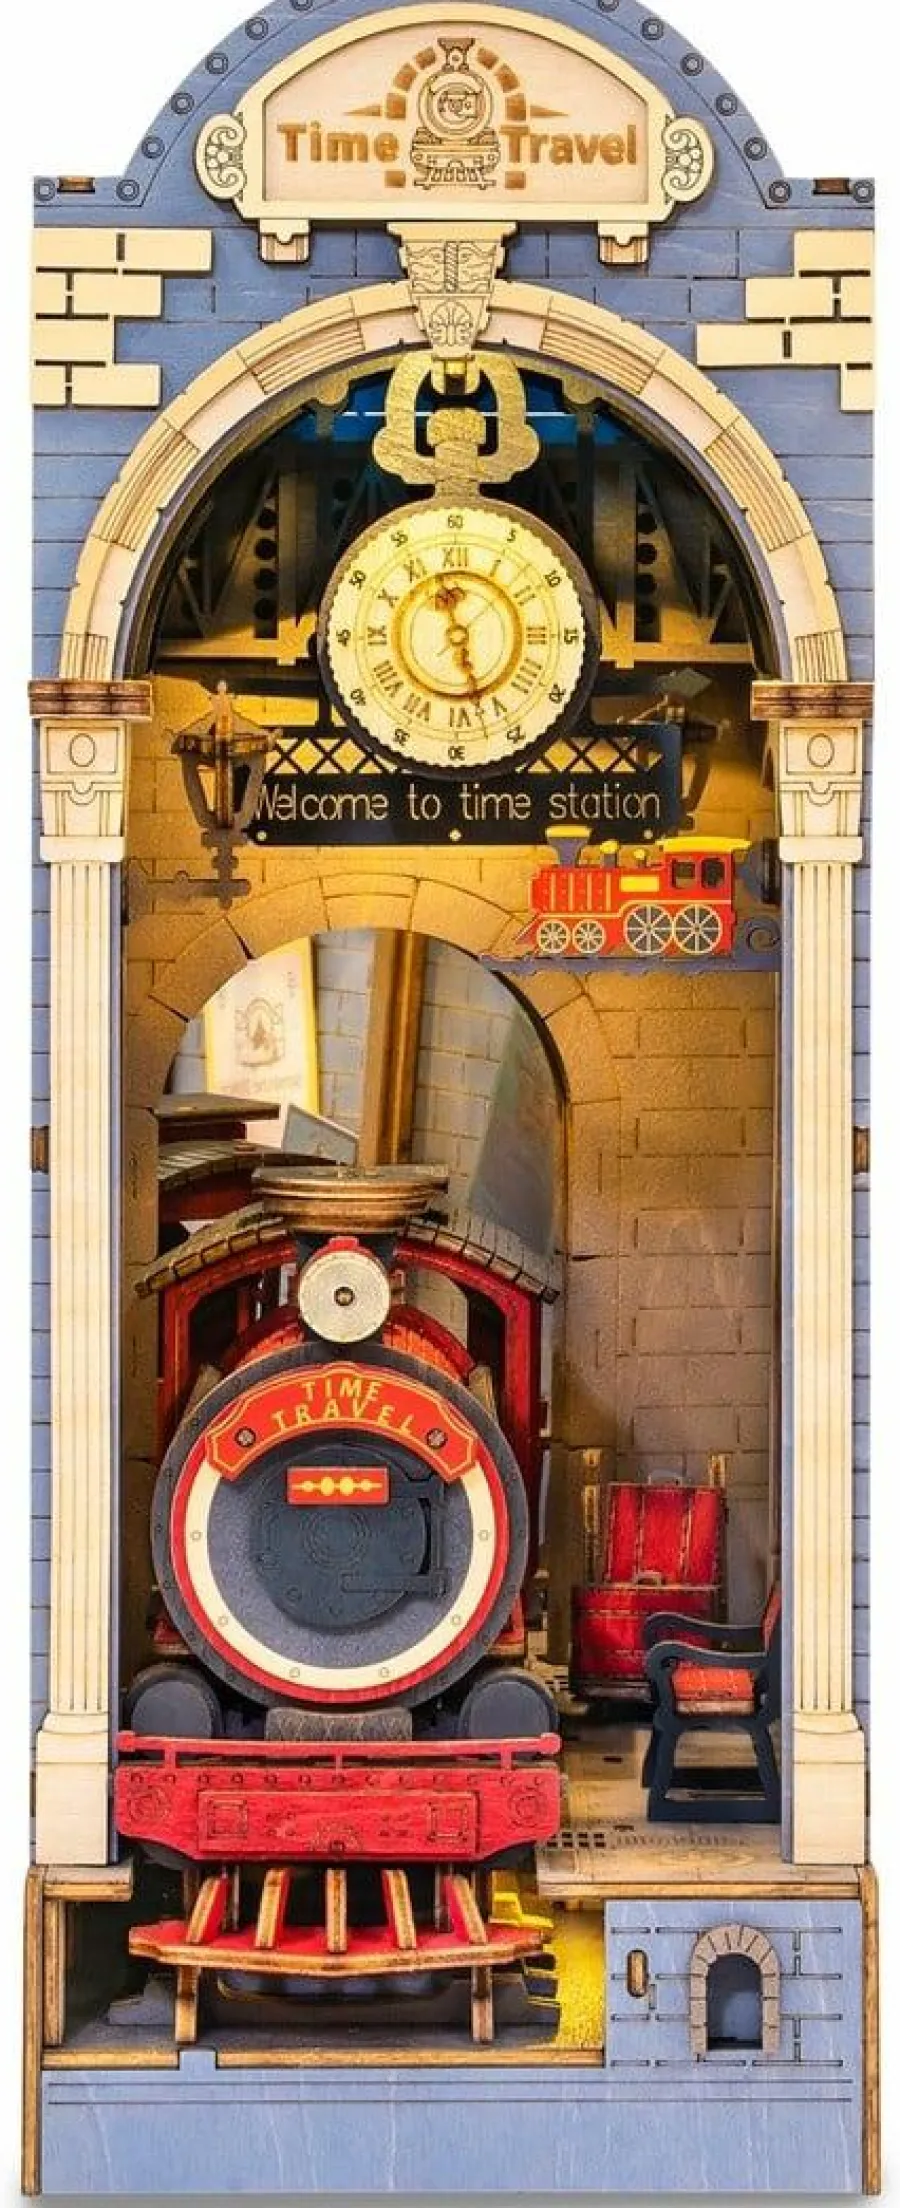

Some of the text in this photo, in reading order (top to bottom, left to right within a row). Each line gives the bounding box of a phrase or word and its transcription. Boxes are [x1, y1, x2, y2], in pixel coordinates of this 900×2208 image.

[277, 121, 637, 164] Time Travel
[448, 515, 463, 529] 60
[391, 530, 408, 546] 55
[507, 529, 516, 542] 5
[442, 548, 468, 567] XII
[404, 558, 427, 582] XI
[490, 560, 501, 577] I
[349, 571, 366, 586] 50
[545, 570, 560, 587] 10
[378, 588, 398, 607] X
[515, 588, 535, 606] II
[336, 629, 350, 645] 45
[368, 626, 387, 645] IX
[527, 627, 546, 644] III
[564, 628, 578, 644] 15
[512, 659, 542, 693] IIII
[351, 689, 366, 706] 40
[549, 686, 564, 704] 20
[394, 729, 410, 745] 35
[507, 727, 525, 743] 25
[448, 745, 465, 760] 30
[254, 783, 660, 820] Welcome to time station
[301, 1378, 382, 1401] TIME
[272, 1398, 414, 1434] TRAVEL
